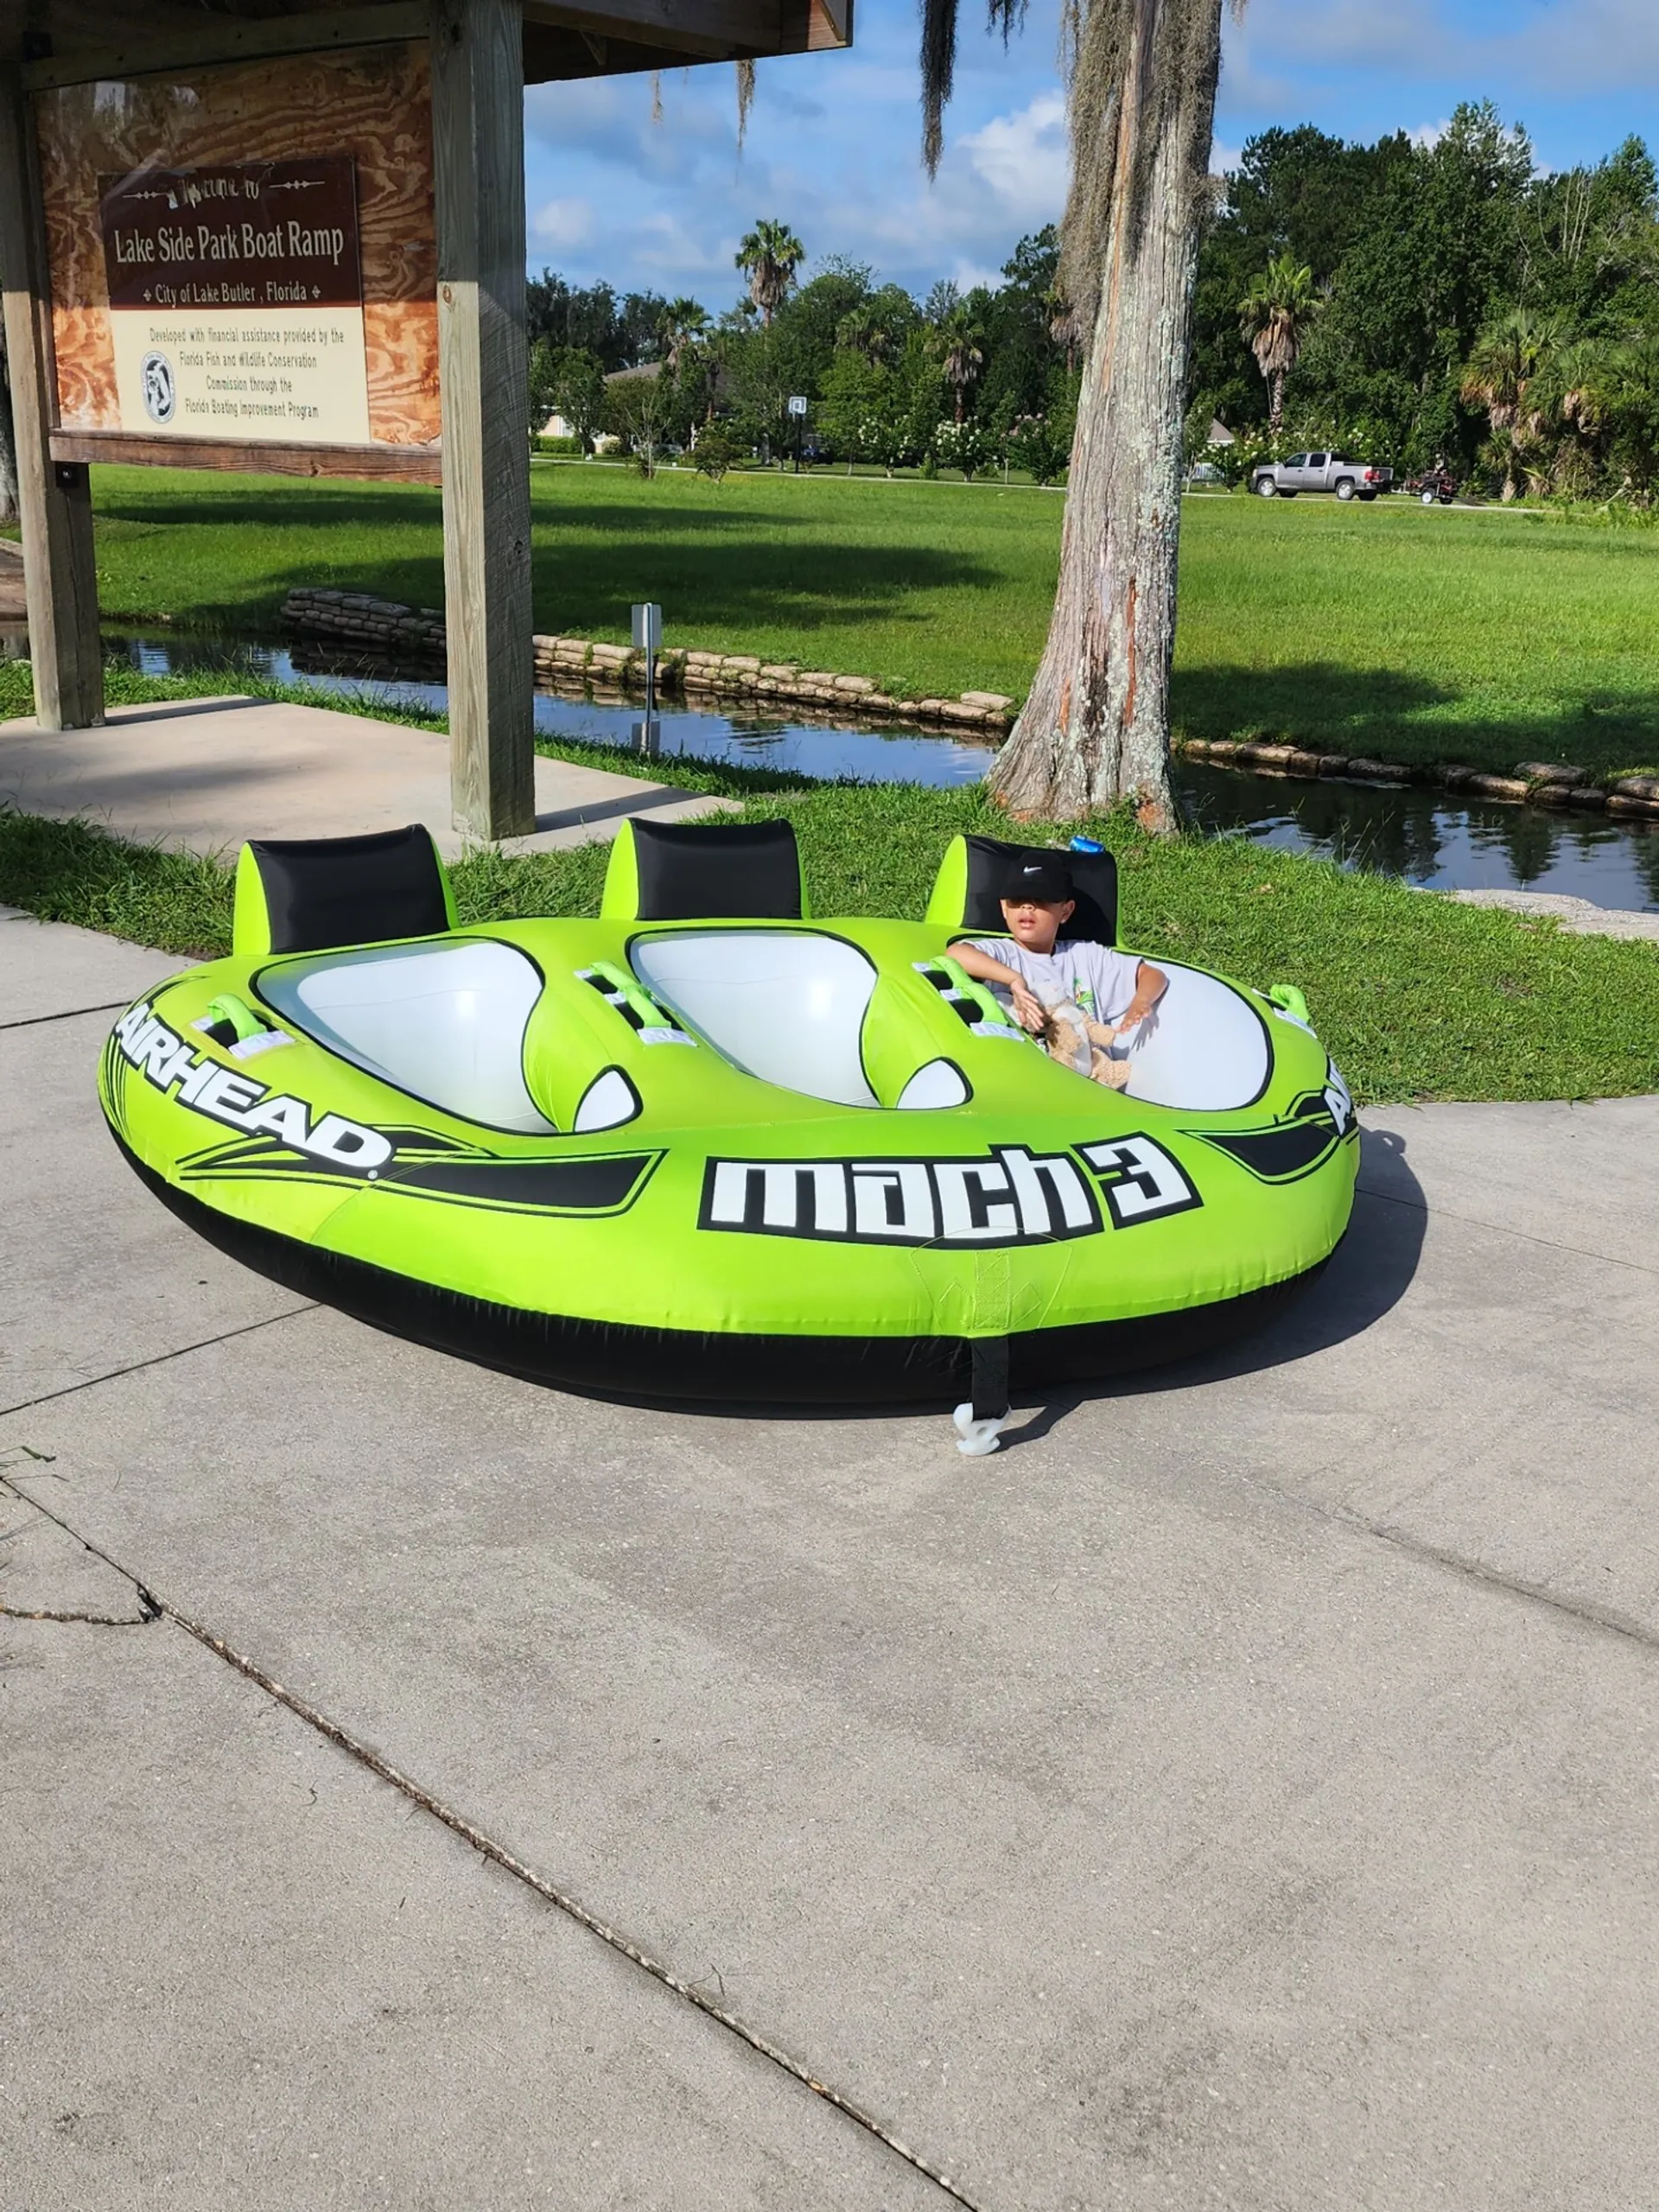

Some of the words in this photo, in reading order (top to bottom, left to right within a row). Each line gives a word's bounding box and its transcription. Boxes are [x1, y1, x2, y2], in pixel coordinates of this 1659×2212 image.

[114, 229, 155, 263] Lake
[157, 226, 195, 262] Side
[197, 224, 240, 260] Park
[240, 223, 285, 258] Boat
[287, 220, 344, 265] Ramp
[155, 283, 177, 308] City
[180, 283, 191, 302] of
[193, 283, 219, 303] Lake
[266, 281, 308, 302] Florida
[149, 327, 187, 346] Developed
[189, 327, 205, 342] with
[207, 327, 239, 342] financial
[241, 327, 281, 343] assistance
[283, 327, 316, 346] provided
[318, 327, 327, 346] by
[330, 327, 345, 344] the
[179, 350, 204, 366] Florida
[206, 350, 221, 366] Fish
[223, 353, 237, 367] and
[238, 351, 266, 367] Wildlife
[268, 351, 317, 368] Conservation
[206, 374, 248, 391] Commission
[249, 375, 278, 395] through
[279, 376, 293, 393] the
[185, 397, 210, 414] Florida
[212, 397, 238, 418] Boating
[239, 398, 287, 419] Improvement
[288, 400, 320, 422] Program
[114, 1002, 392, 1169] AIRHEAD
